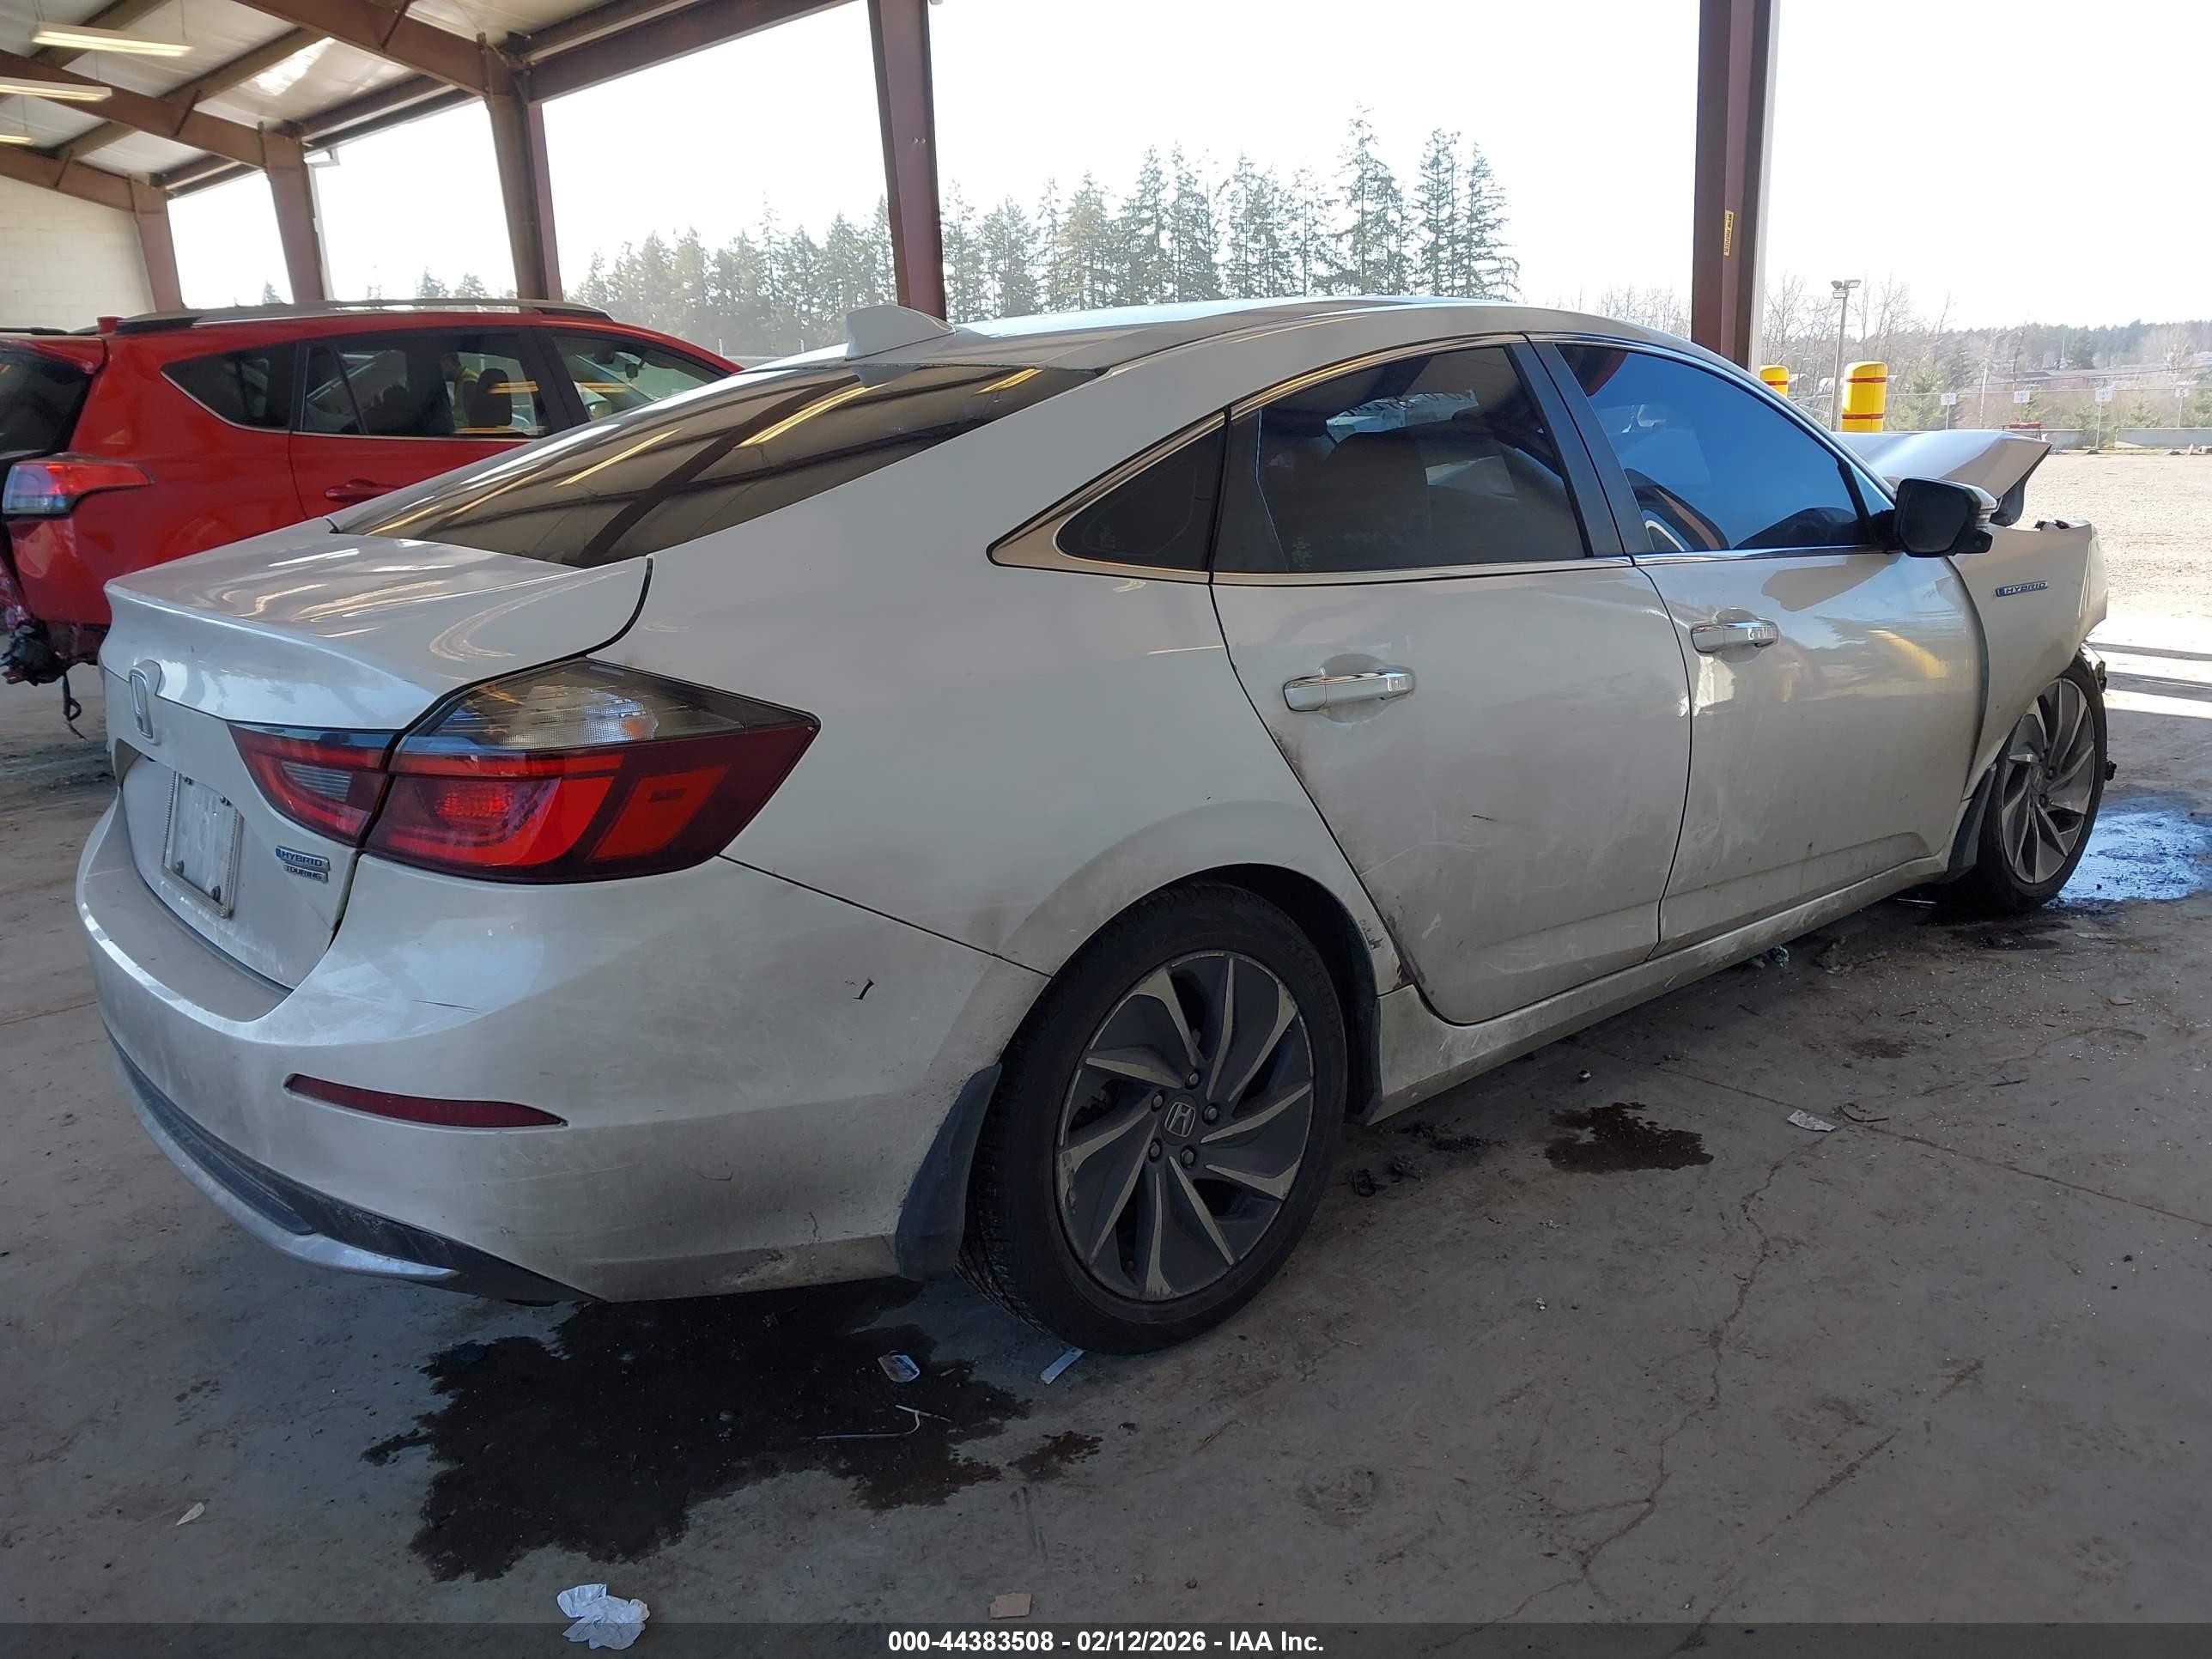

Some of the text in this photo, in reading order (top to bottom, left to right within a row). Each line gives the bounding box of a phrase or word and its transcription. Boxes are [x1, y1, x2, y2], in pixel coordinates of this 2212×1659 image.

[2179, 388, 2185, 397] 5
[2005, 582, 2046, 594] HYBRID
[281, 850, 323, 867] HYBRID
[284, 865, 323, 880] TOURING
